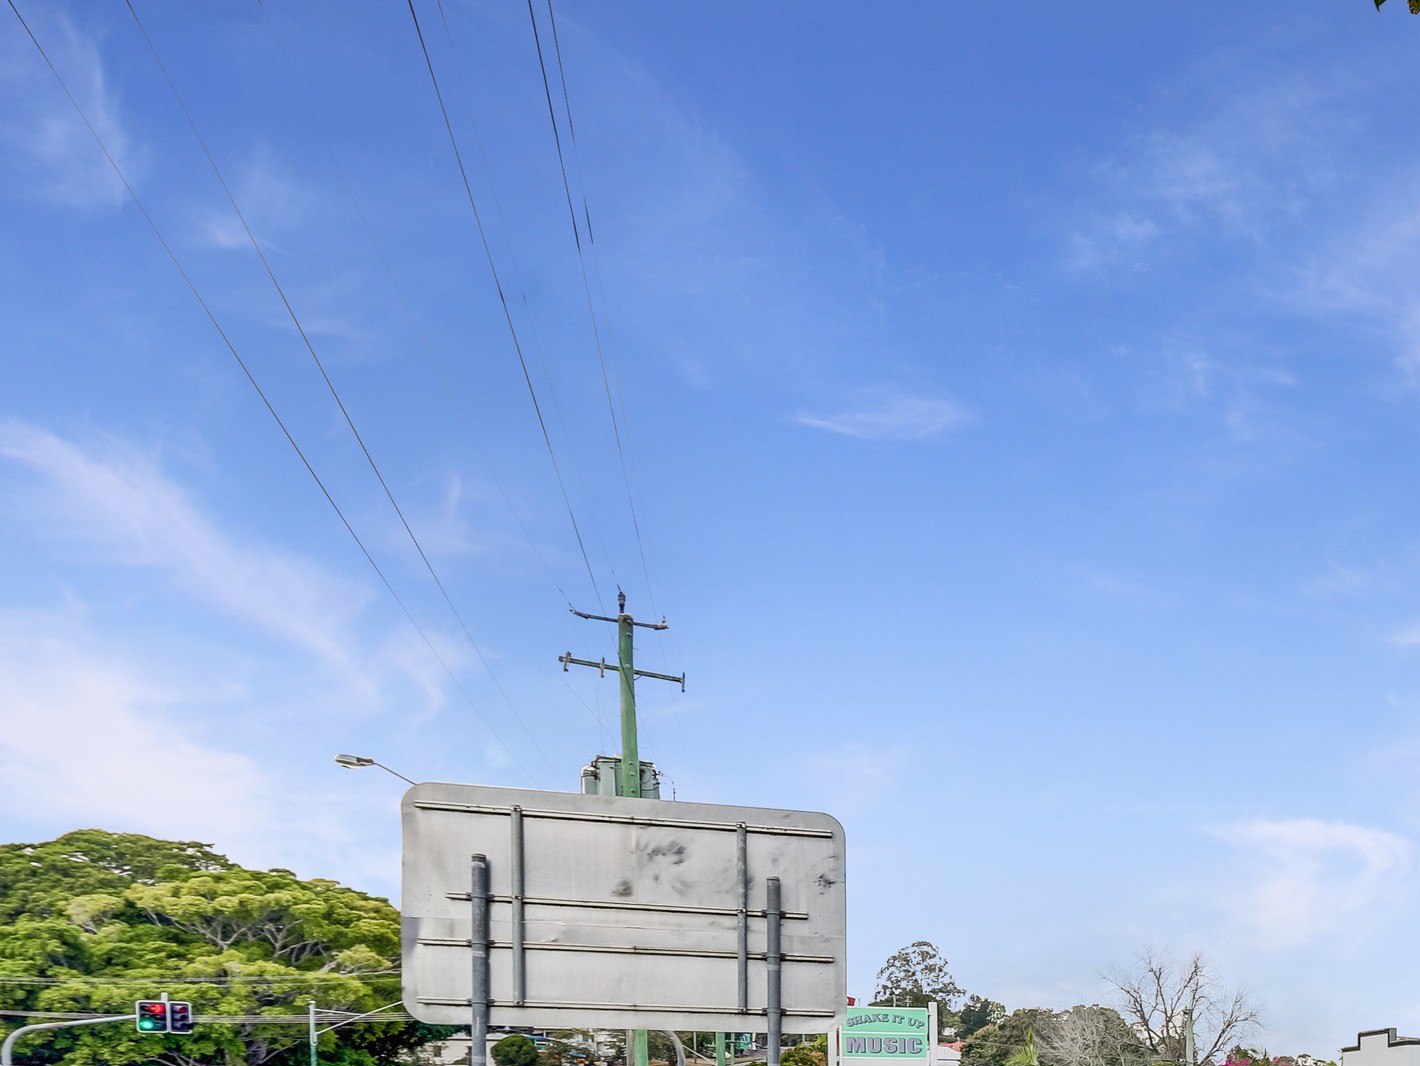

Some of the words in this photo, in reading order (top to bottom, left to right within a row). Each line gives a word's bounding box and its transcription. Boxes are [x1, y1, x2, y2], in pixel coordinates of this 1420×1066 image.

[846, 1013, 890, 1027] SHAKE
[892, 1014, 905, 1024] IT
[908, 1017, 925, 1029] UP
[846, 1037, 923, 1054] MUSIC
